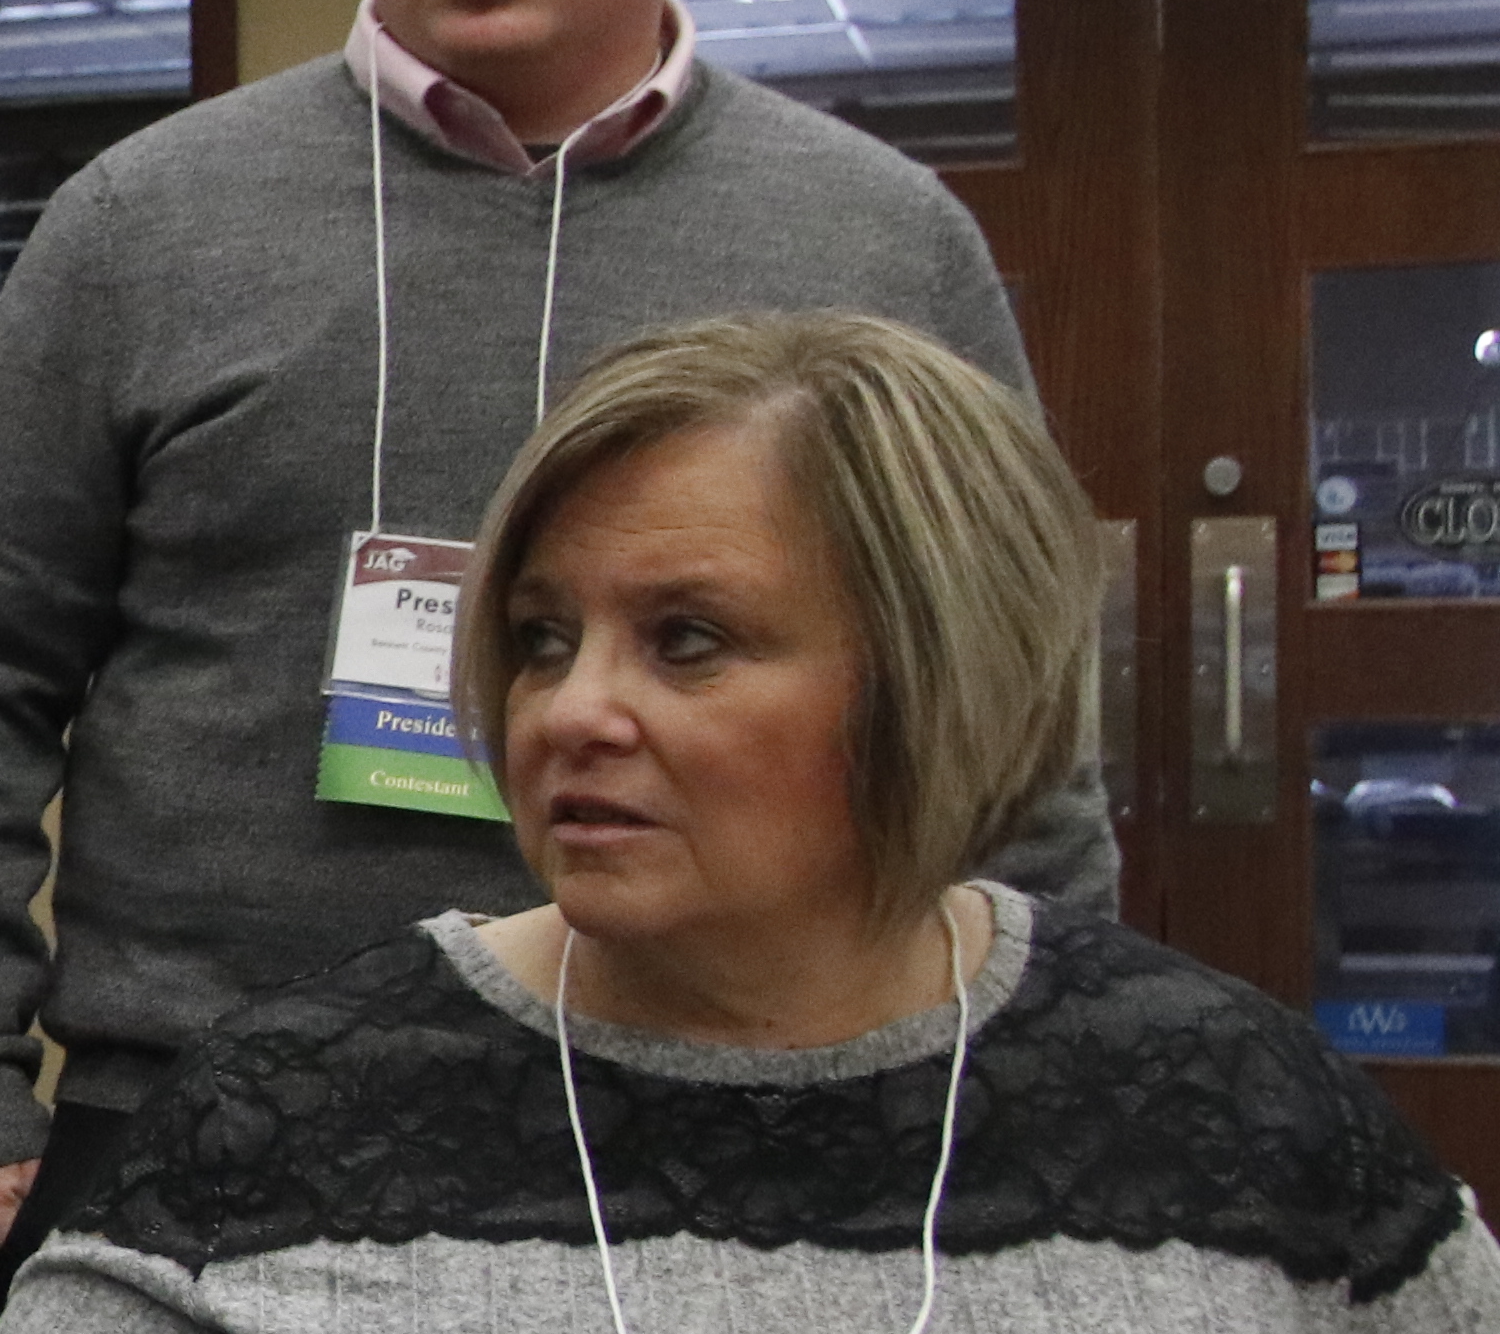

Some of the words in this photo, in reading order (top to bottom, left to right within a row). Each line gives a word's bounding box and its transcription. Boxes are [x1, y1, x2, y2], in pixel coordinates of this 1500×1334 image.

[363, 549, 407, 572] JAG
[396, 588, 453, 614] Pres
[377, 710, 478, 741] Presidet
[370, 770, 469, 796] Contestant
